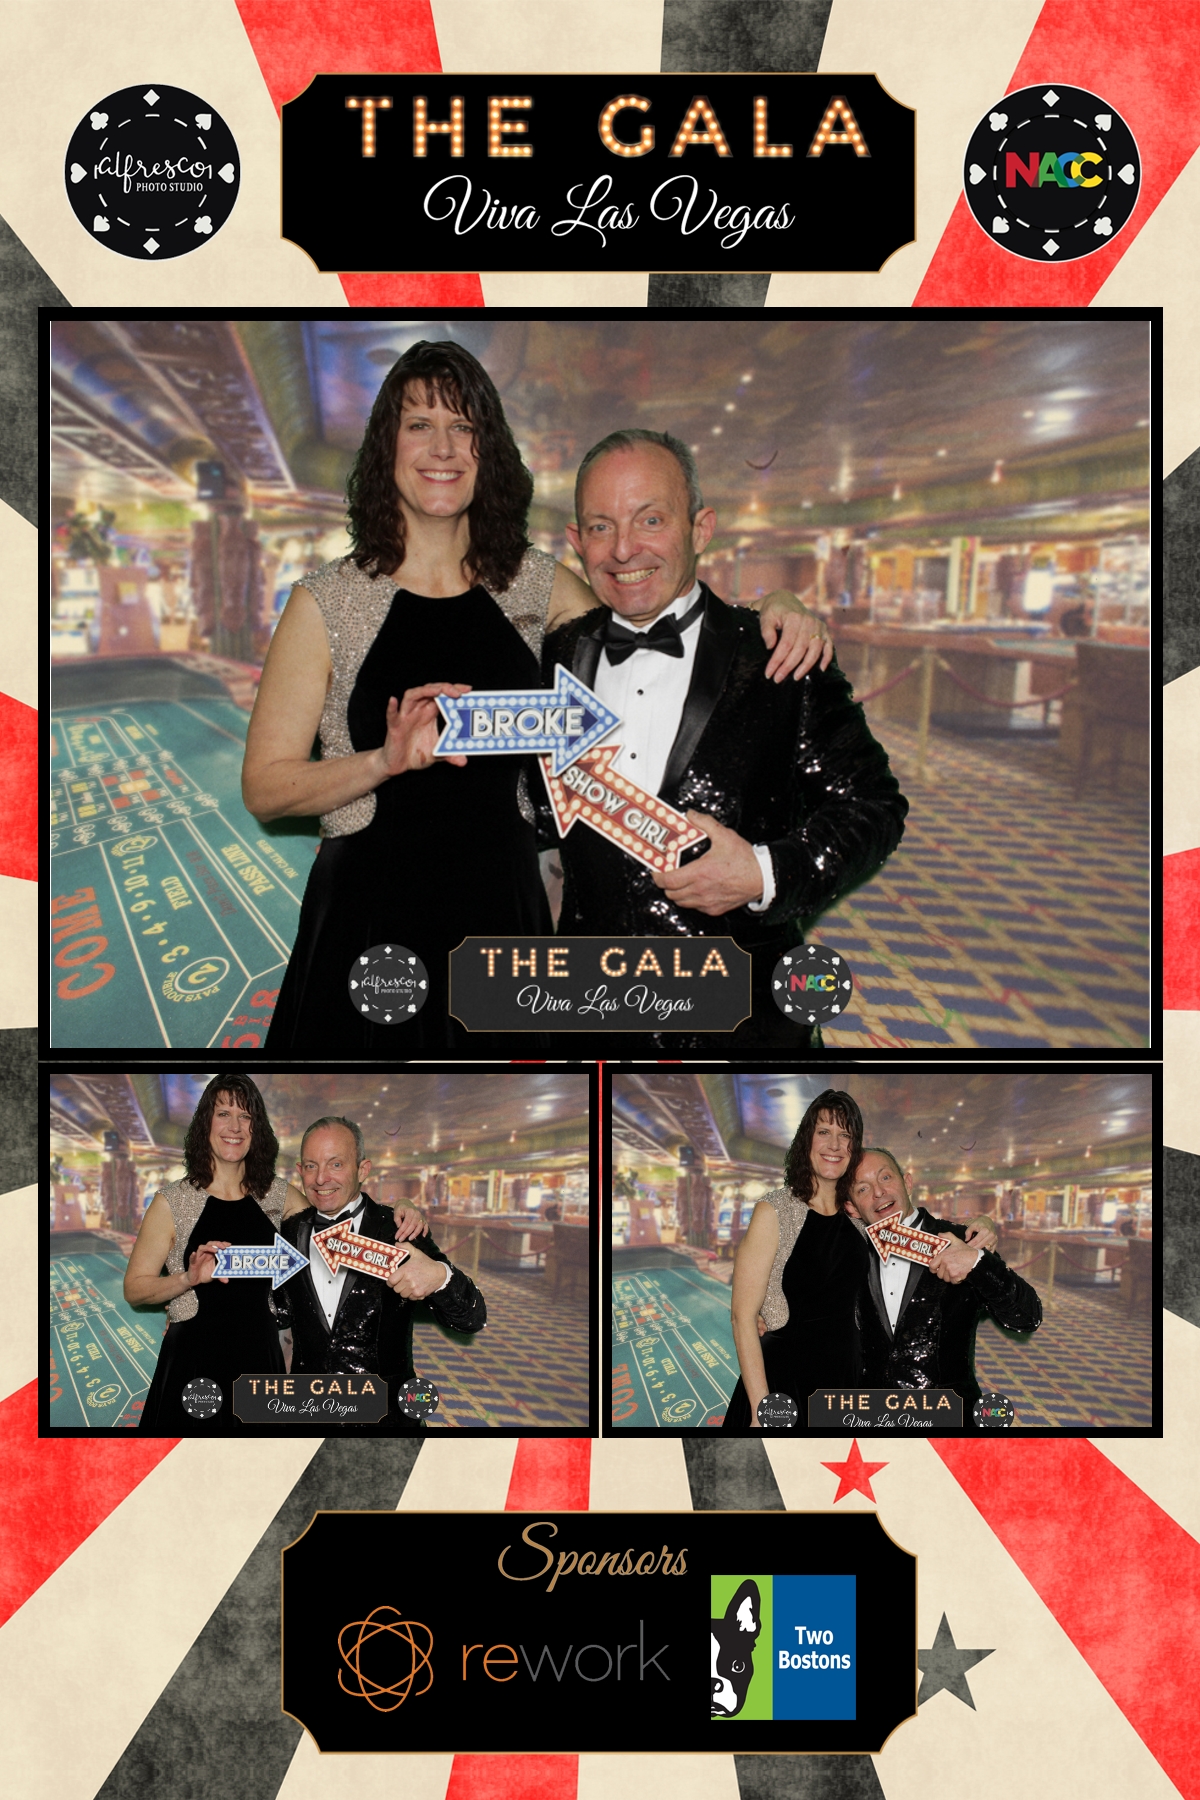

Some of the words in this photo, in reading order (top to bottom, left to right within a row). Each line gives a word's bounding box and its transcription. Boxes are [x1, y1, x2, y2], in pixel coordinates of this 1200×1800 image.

[471, 707, 584, 738] BROKE
[562, 765, 627, 815] SHOW
[623, 808, 671, 851] GIRL
[221, 844, 252, 868] LINE
[160, 876, 193, 910] FIELD
[238, 865, 275, 895] PASS
[51, 886, 116, 1000] COME
[188, 963, 219, 984] 2
[184, 985, 220, 1002] PAYS
[326, 1237, 363, 1257] SHOW
[362, 1251, 390, 1268] GIRL
[879, 1229, 910, 1246] SHOW
[910, 1240, 934, 1257] GIRL
[230, 1255, 291, 1270] BROKE
